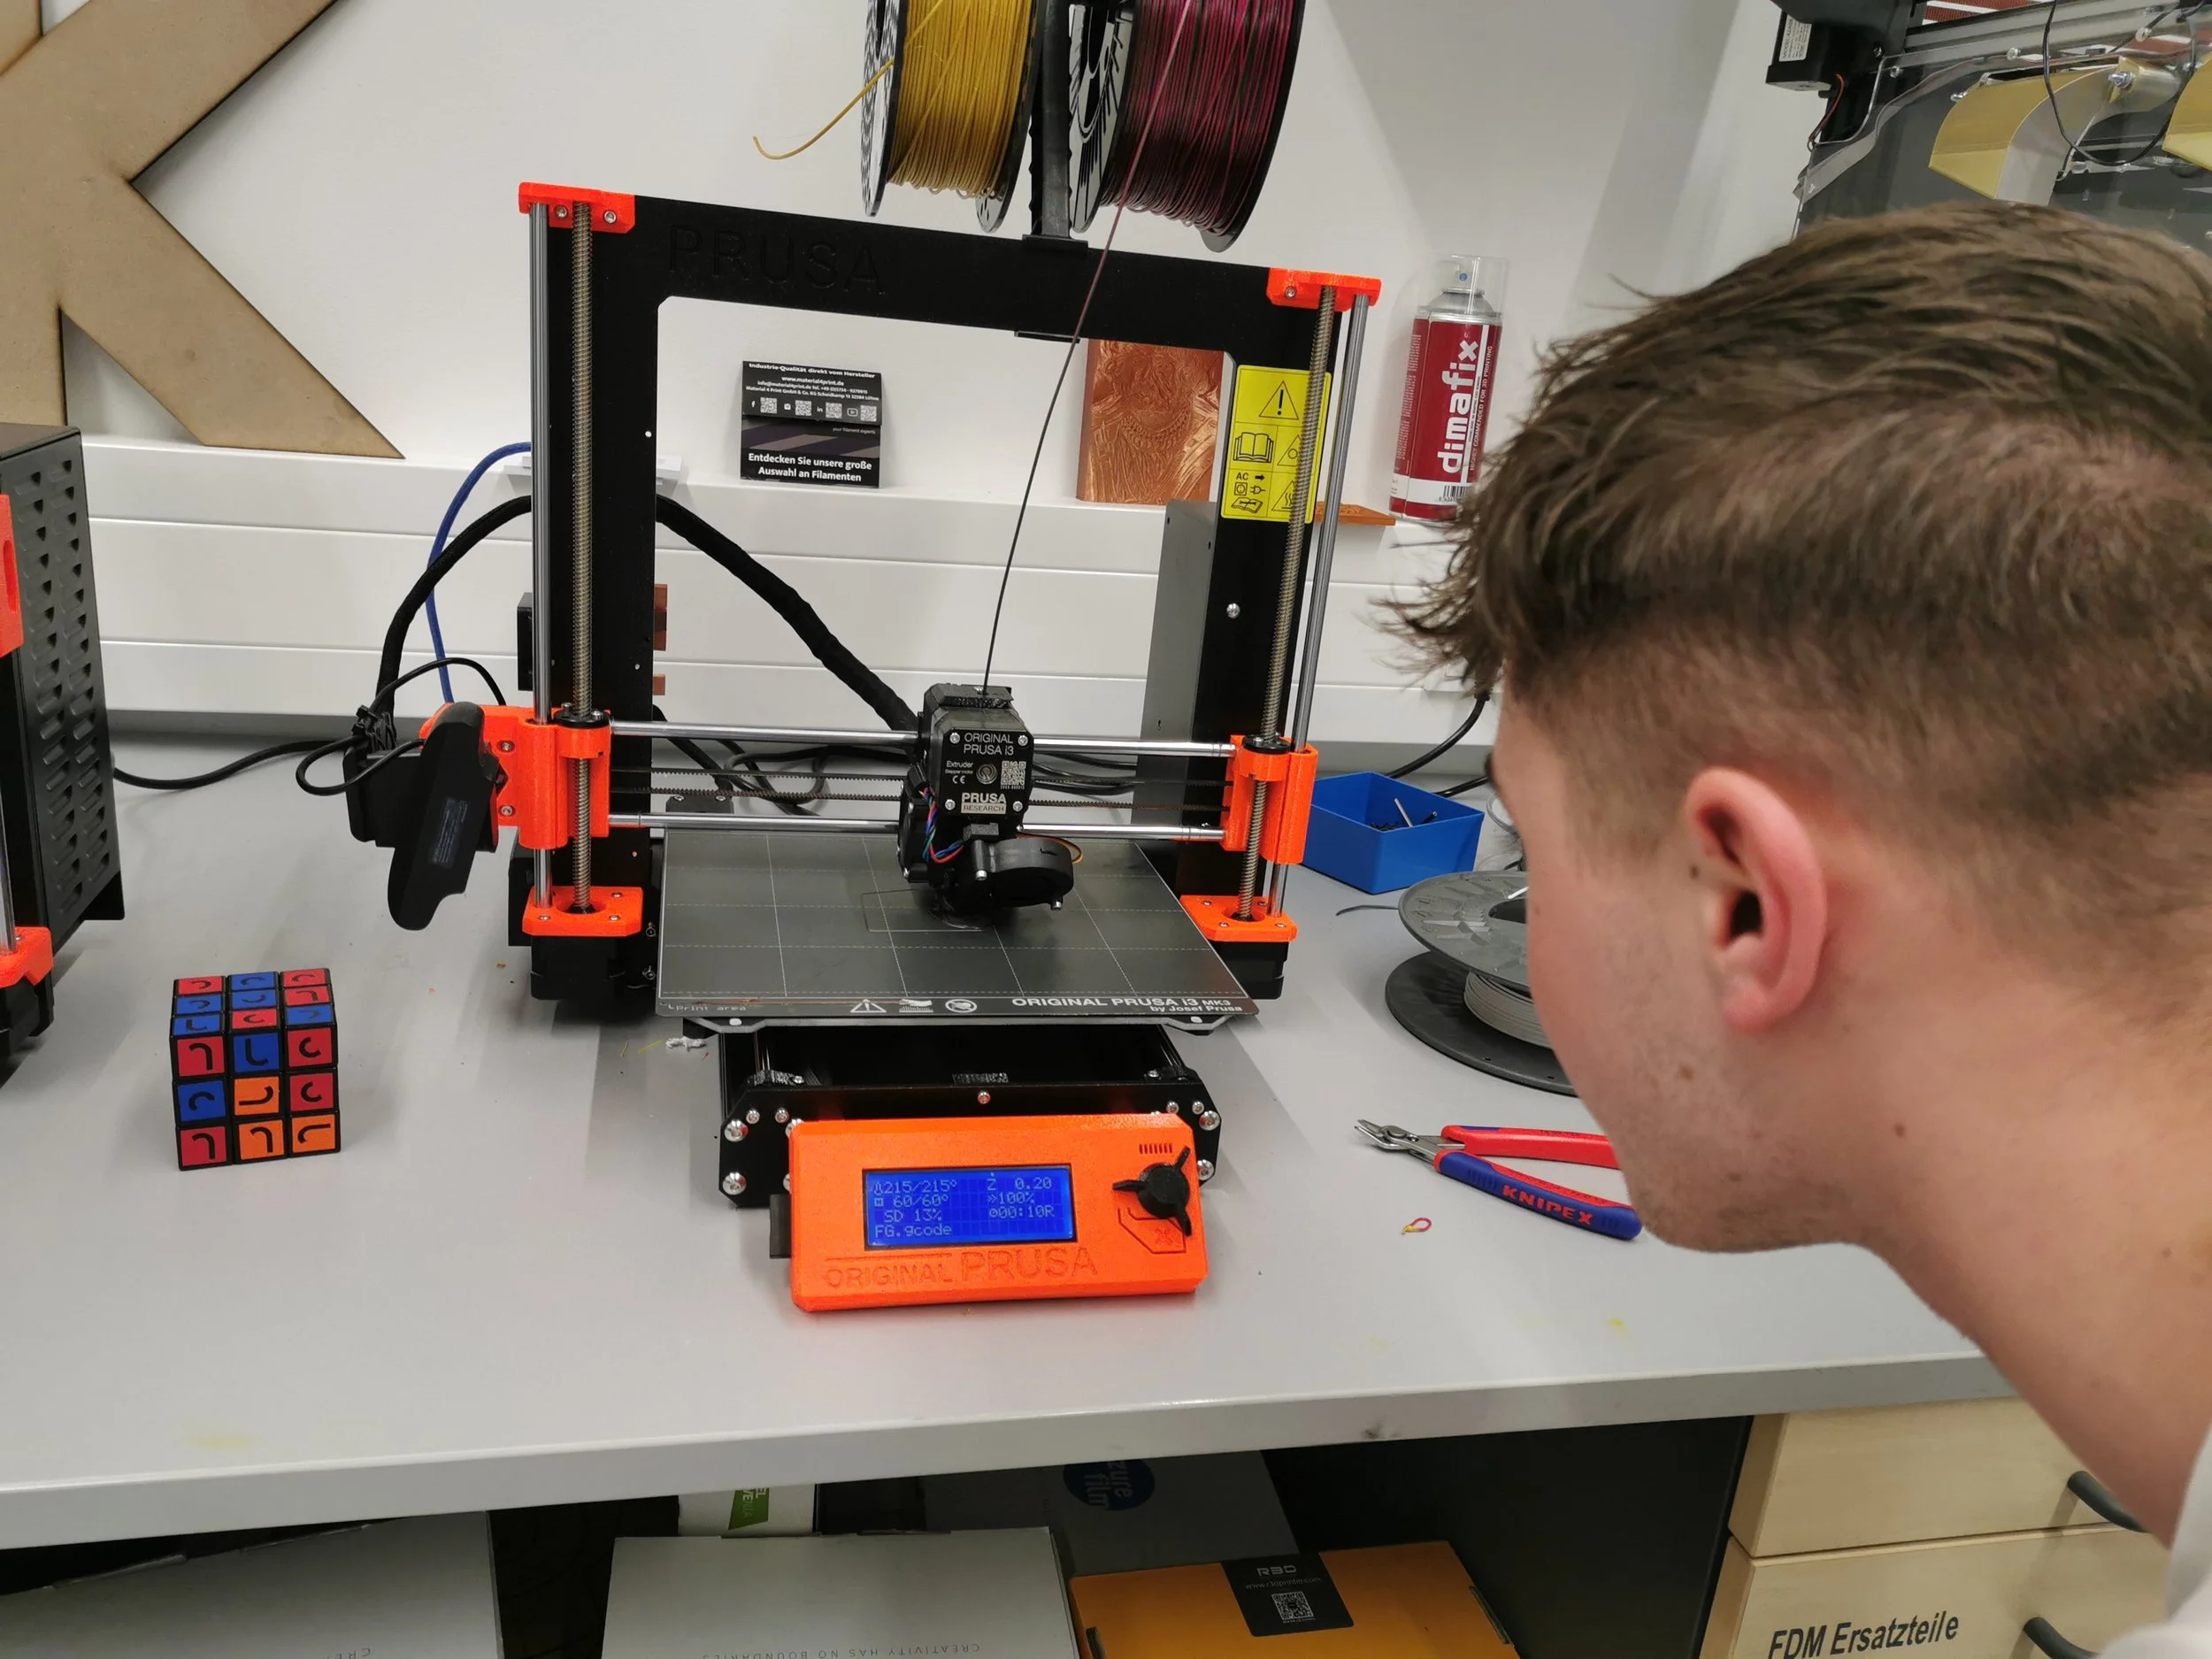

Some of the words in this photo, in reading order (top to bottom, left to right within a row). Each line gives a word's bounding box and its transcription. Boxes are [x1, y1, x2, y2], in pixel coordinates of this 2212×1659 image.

[670, 223, 886, 295] PRUSA
[1483, 346, 1493, 378] PRINTING
[1481, 379, 1488, 388] 3D
[1437, 340, 1479, 474] dimafix
[1473, 403, 1485, 447] COMMENDED
[749, 452, 795, 465] Entdecken
[797, 457, 811, 465] Sie
[813, 458, 844, 467] unsere
[844, 461, 872, 471] große
[758, 466, 797, 477] Auswahl
[811, 470, 862, 481] Filamenten
[1236, 472, 1249, 480] AC
[964, 733, 1014, 743] ORIGINAL
[964, 744, 1002, 756] PRUSA
[1004, 745, 1014, 756] i3
[962, 792, 1007, 803] PRUSA
[963, 803, 1004, 812] RESEARCH
[1011, 998, 1109, 1007] ORIGINAL
[1110, 997, 1179, 1007] PRUSA
[1180, 998, 1199, 1007] i3
[1014, 1176, 1052, 1190] 0.20
[1502, 1185, 1594, 1225] KNIPEX
[884, 1210, 903, 1223] SD
[914, 1209, 942, 1222] 13%
[874, 1223, 953, 1238] FG.gcode
[824, 1263, 953, 1289] ORIGINAL
[960, 1248, 1098, 1283] PRUSA
[1084, 1472, 1111, 1509] film
[1257, 1565, 1297, 1576] R3D
[1768, 1624, 1828, 1659] FDM
[1830, 1610, 1959, 1655] Ersatzteile
[818, 1649, 839, 1659] NO
[849, 1648, 879, 1657] HAS
[887, 1643, 980, 1656] CREATIVITY
